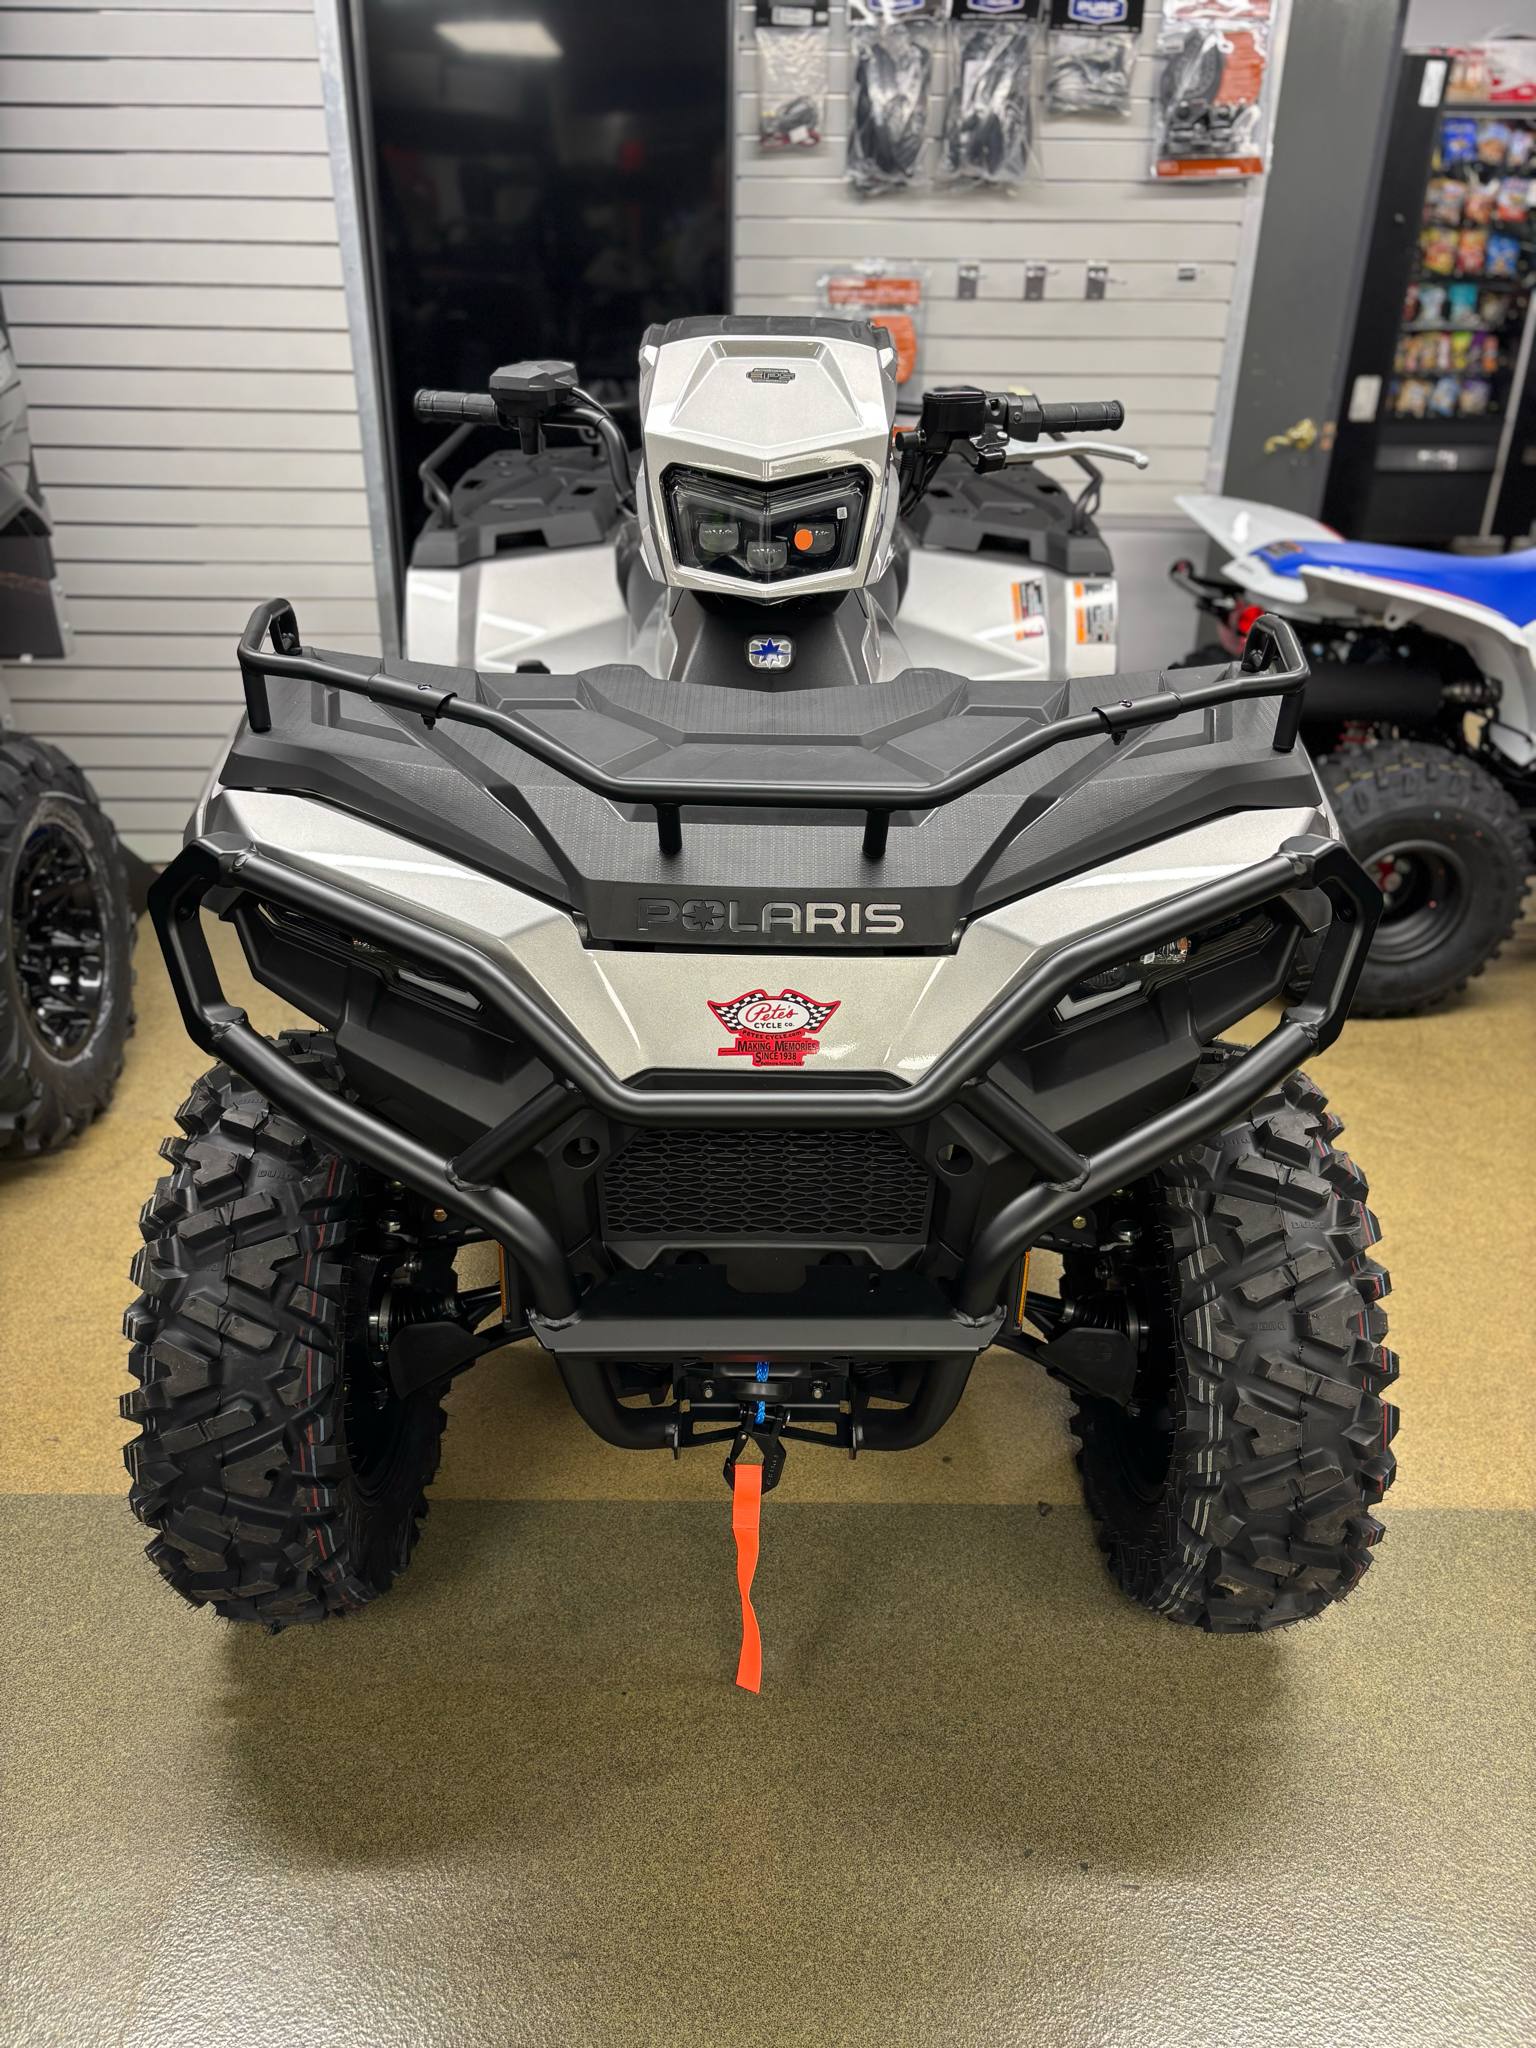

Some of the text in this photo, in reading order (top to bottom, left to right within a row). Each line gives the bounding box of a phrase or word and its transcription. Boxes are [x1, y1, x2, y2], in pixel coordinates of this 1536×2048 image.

[637, 897, 905, 935] POLARIS
[745, 1002, 799, 1023] Pete's
[737, 1041, 816, 1052] MAKING MEMORIES
[755, 1052, 797, 1063] SINCE 1938
